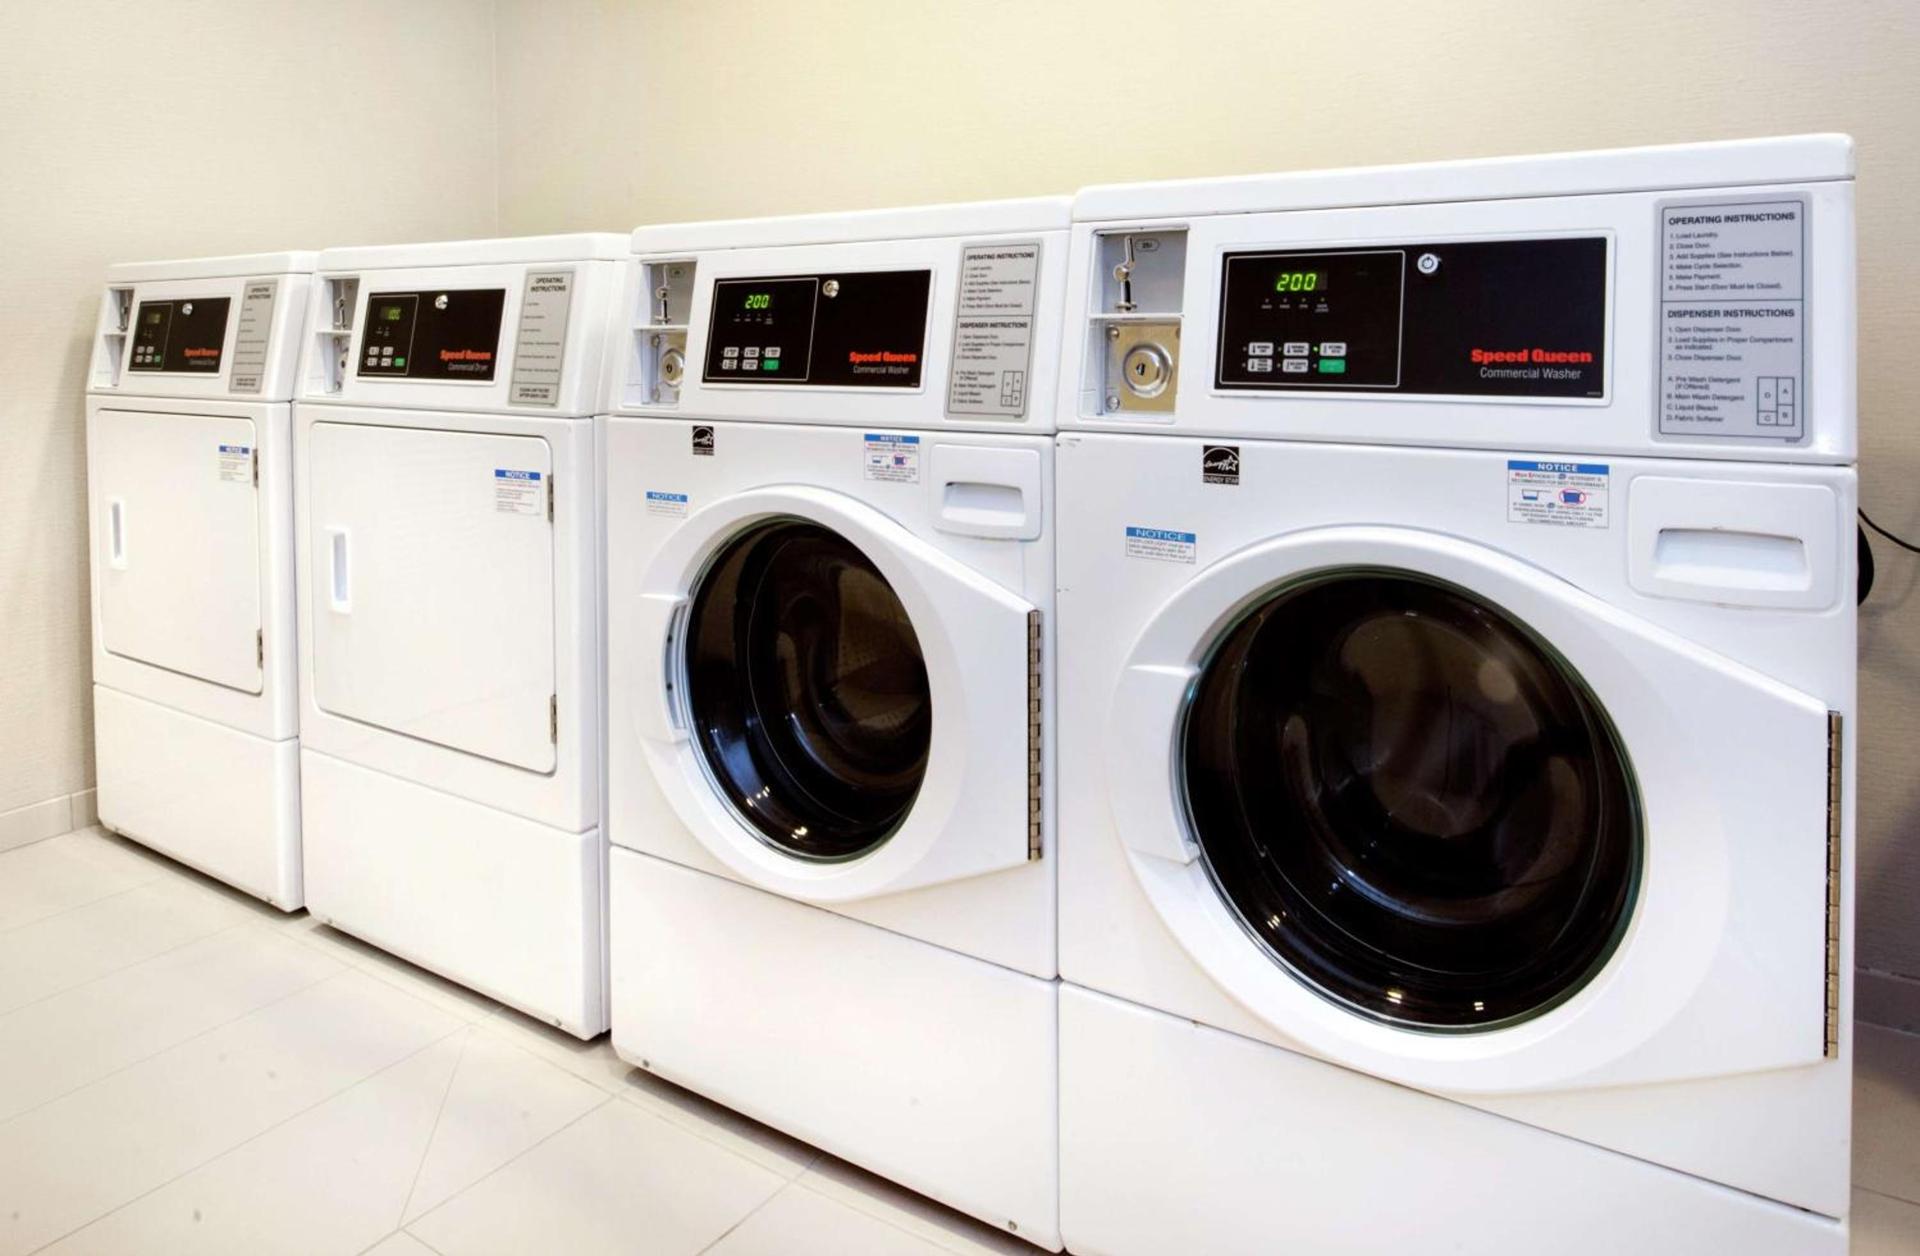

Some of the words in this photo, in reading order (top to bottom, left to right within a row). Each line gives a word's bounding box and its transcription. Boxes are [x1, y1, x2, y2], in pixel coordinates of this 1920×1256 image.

[1668, 215, 1722, 226] OPERATING
[1724, 212, 1795, 223] INSTRUCTIONS
[966, 253, 995, 261] OPERATING
[996, 252, 1034, 260] INSTRUCTIONS
[1690, 253, 1716, 261] Supplies
[1276, 273, 1317, 292] 200
[745, 294, 770, 309] 200
[1668, 310, 1721, 319] DISPENSER
[1723, 309, 1795, 318] INSTRUCTIONS
[1693, 326, 1724, 334] Dispenser
[1750, 336, 1793, 344] Compartment
[440, 350, 465, 361] Speed
[466, 350, 491, 360] Queen
[850, 352, 882, 364] Speed
[884, 352, 916, 362] Queen
[1471, 348, 1528, 365] Speed
[1531, 348, 1592, 363] Queen
[853, 366, 886, 374] Commercial
[888, 366, 910, 374] Washer
[1480, 366, 1540, 378] Commercial
[1542, 368, 1582, 380] Washer
[1712, 394, 1744, 402] Detergent
[1675, 404, 1694, 412] Liquid
[880, 434, 903, 442] NOTICE
[1537, 462, 1578, 472] NOTICE
[506, 470, 530, 480] NOTICE
[652, 492, 680, 502] NOTICE
[1136, 529, 1184, 541] NOTICE
